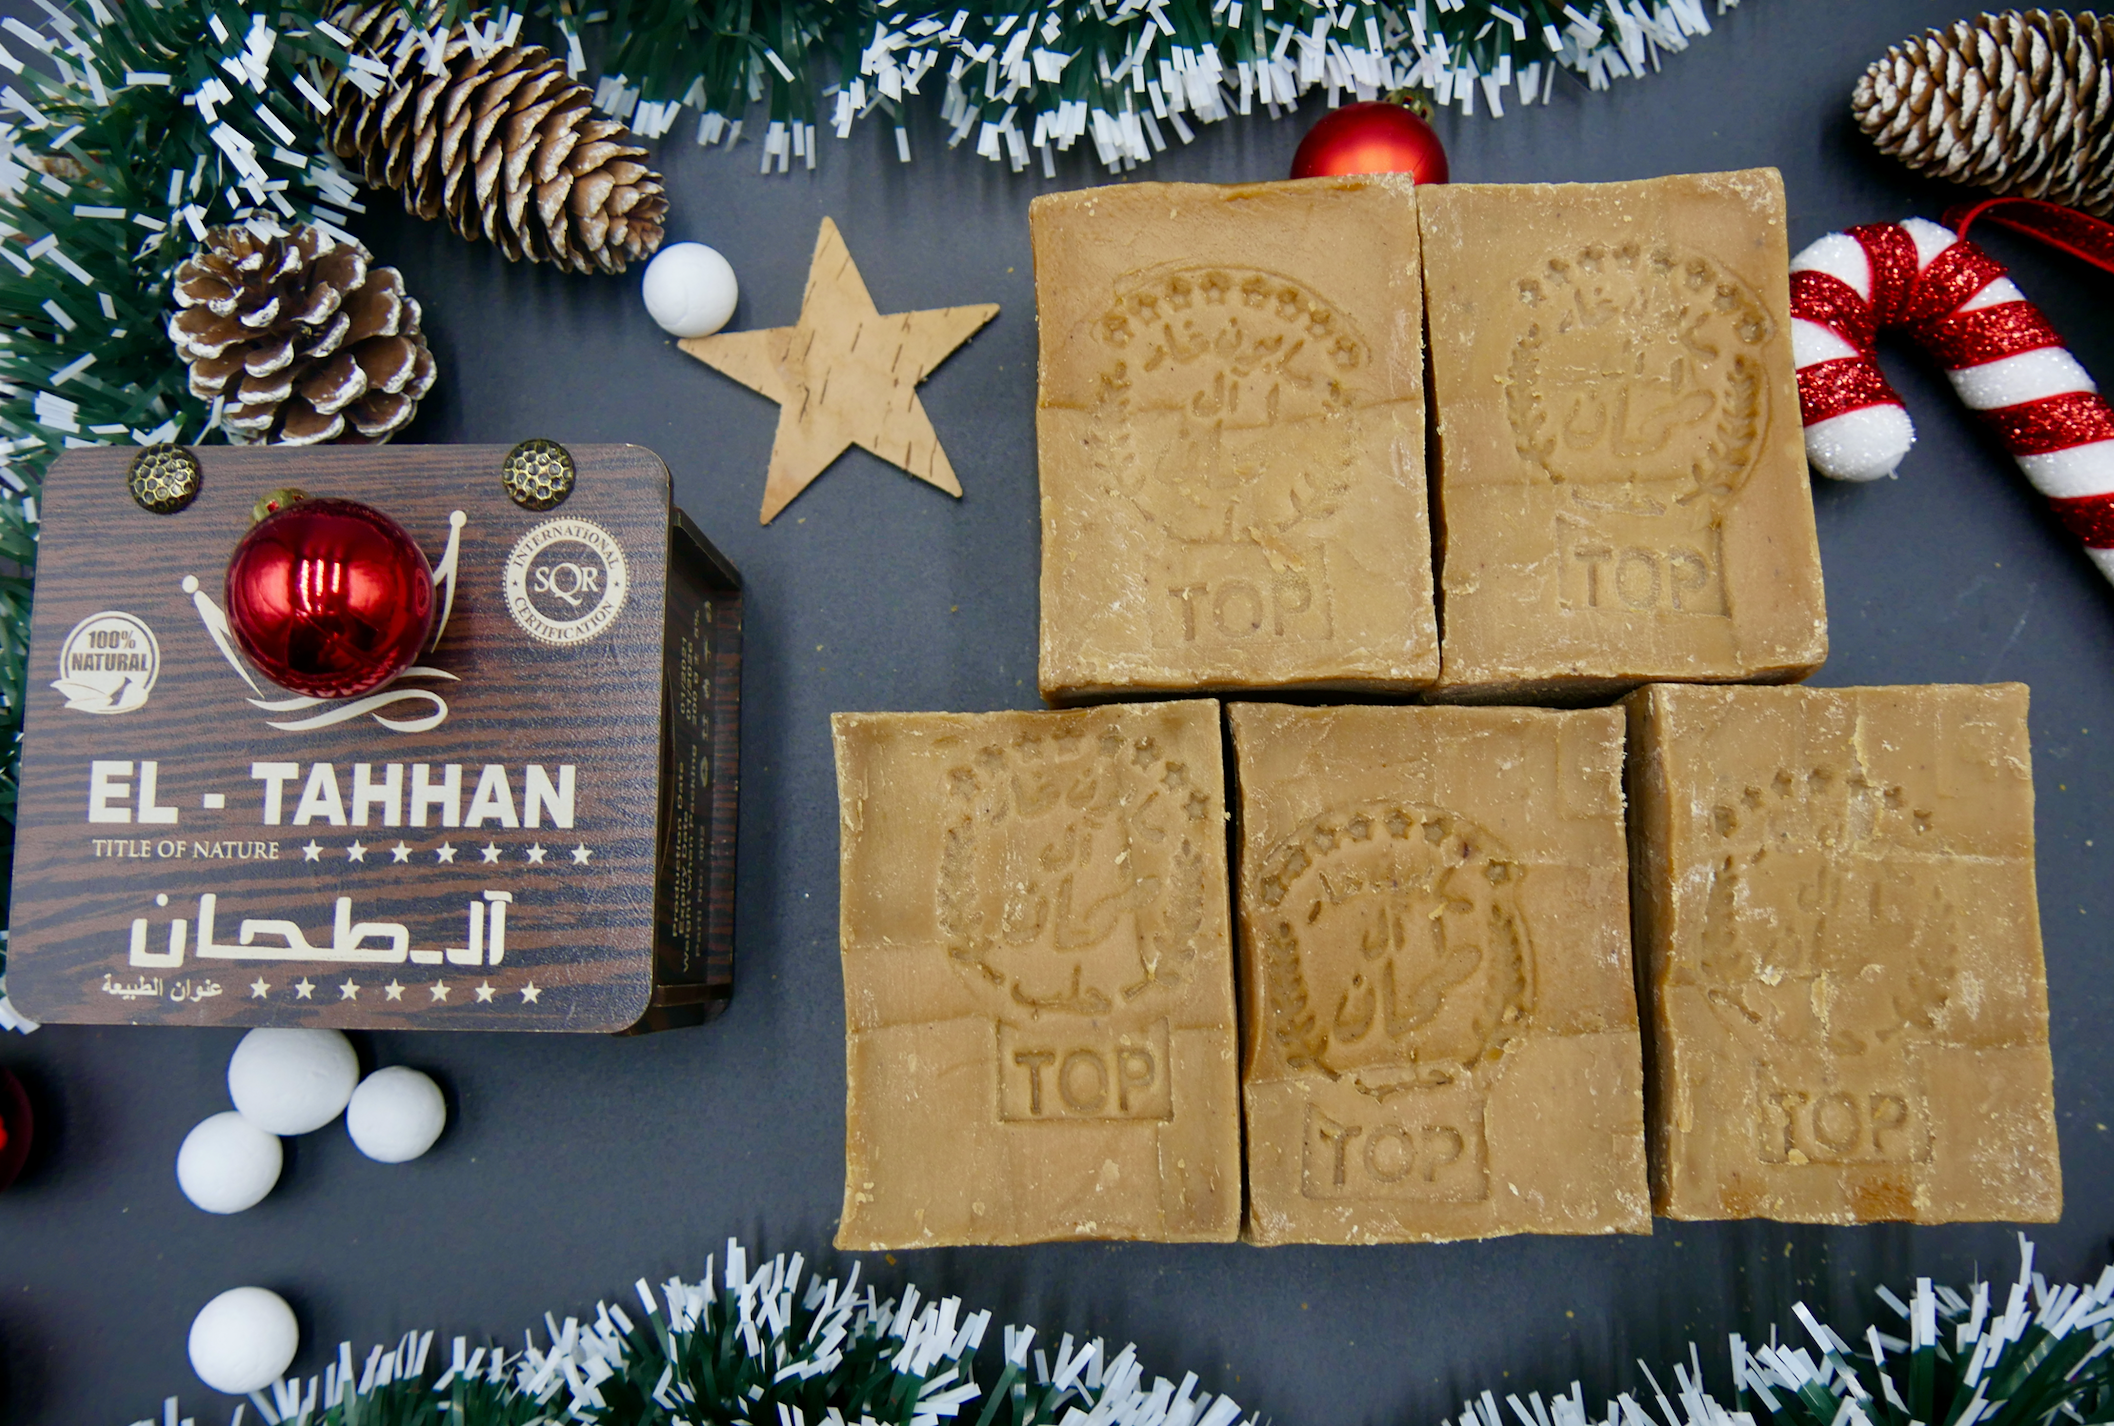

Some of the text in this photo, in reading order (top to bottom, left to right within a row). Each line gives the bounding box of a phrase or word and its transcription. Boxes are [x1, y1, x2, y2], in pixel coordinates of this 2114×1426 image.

[512, 524, 620, 571] INTERNATIONAL
[1573, 545, 1708, 610] TOP
[533, 562, 600, 607] SQR
[1166, 577, 1313, 643] TOP
[87, 629, 137, 650] 100%
[514, 596, 617, 641] CERTIFICATION
[71, 652, 149, 672] NATURAL
[88, 760, 179, 825] EL
[251, 762, 577, 829] TAHHAN
[672, 636, 688, 937] Production Date 01/2021
[92, 838, 280, 860] TITLE OF NATURE
[682, 810, 690, 858] Date
[684, 899, 693, 972] Weight
[689, 743, 698, 829] Packing
[679, 866, 688, 934] Expiry
[101, 973, 224, 1003] عنوان الطبيعة
[1013, 1047, 1157, 1115] TOP
[1319, 1122, 1464, 1187] TOP
[1767, 1089, 1910, 1156] TOP
